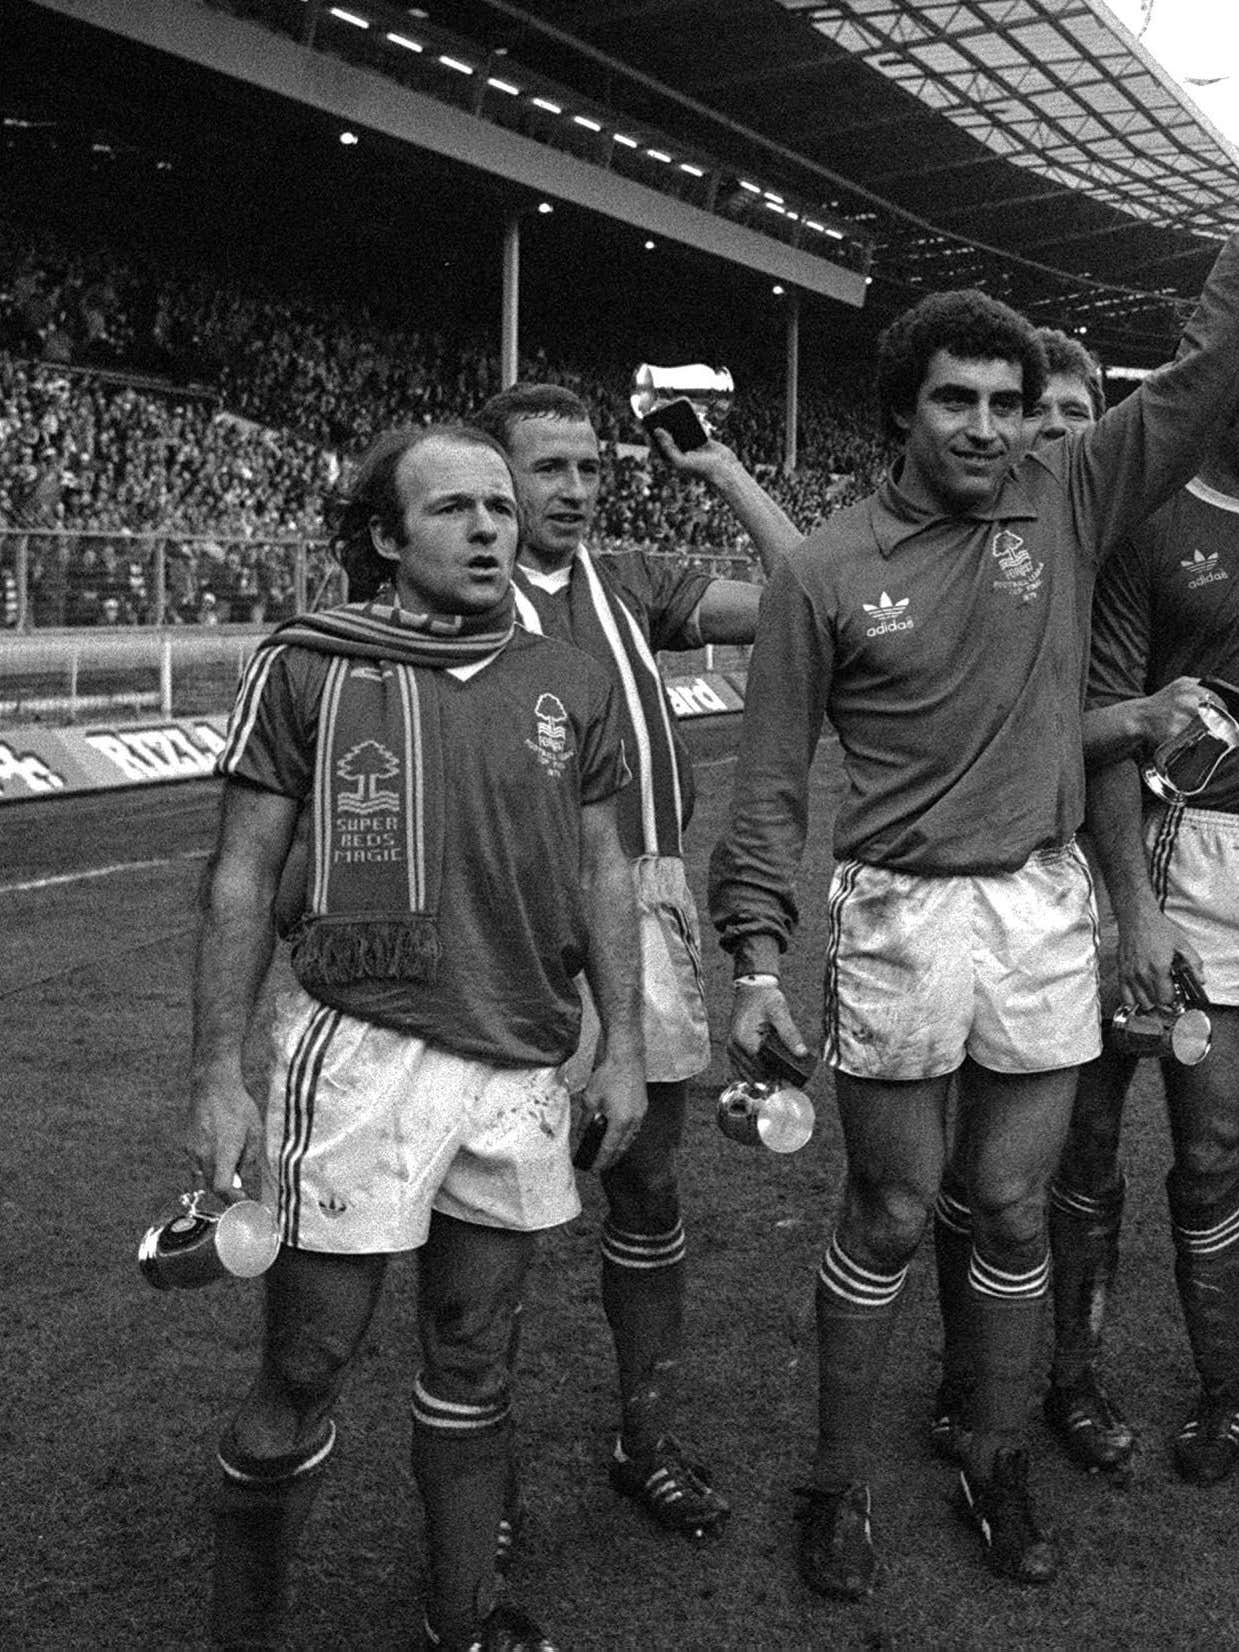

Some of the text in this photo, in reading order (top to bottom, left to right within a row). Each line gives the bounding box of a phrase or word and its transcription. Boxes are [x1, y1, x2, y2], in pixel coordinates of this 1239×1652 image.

[1187, 569, 1230, 590] adidas
[866, 615, 915, 638] adidas
[336, 816, 398, 832] SUPER
[341, 832, 396, 848] REDS
[333, 847, 404, 864] MAGIC
